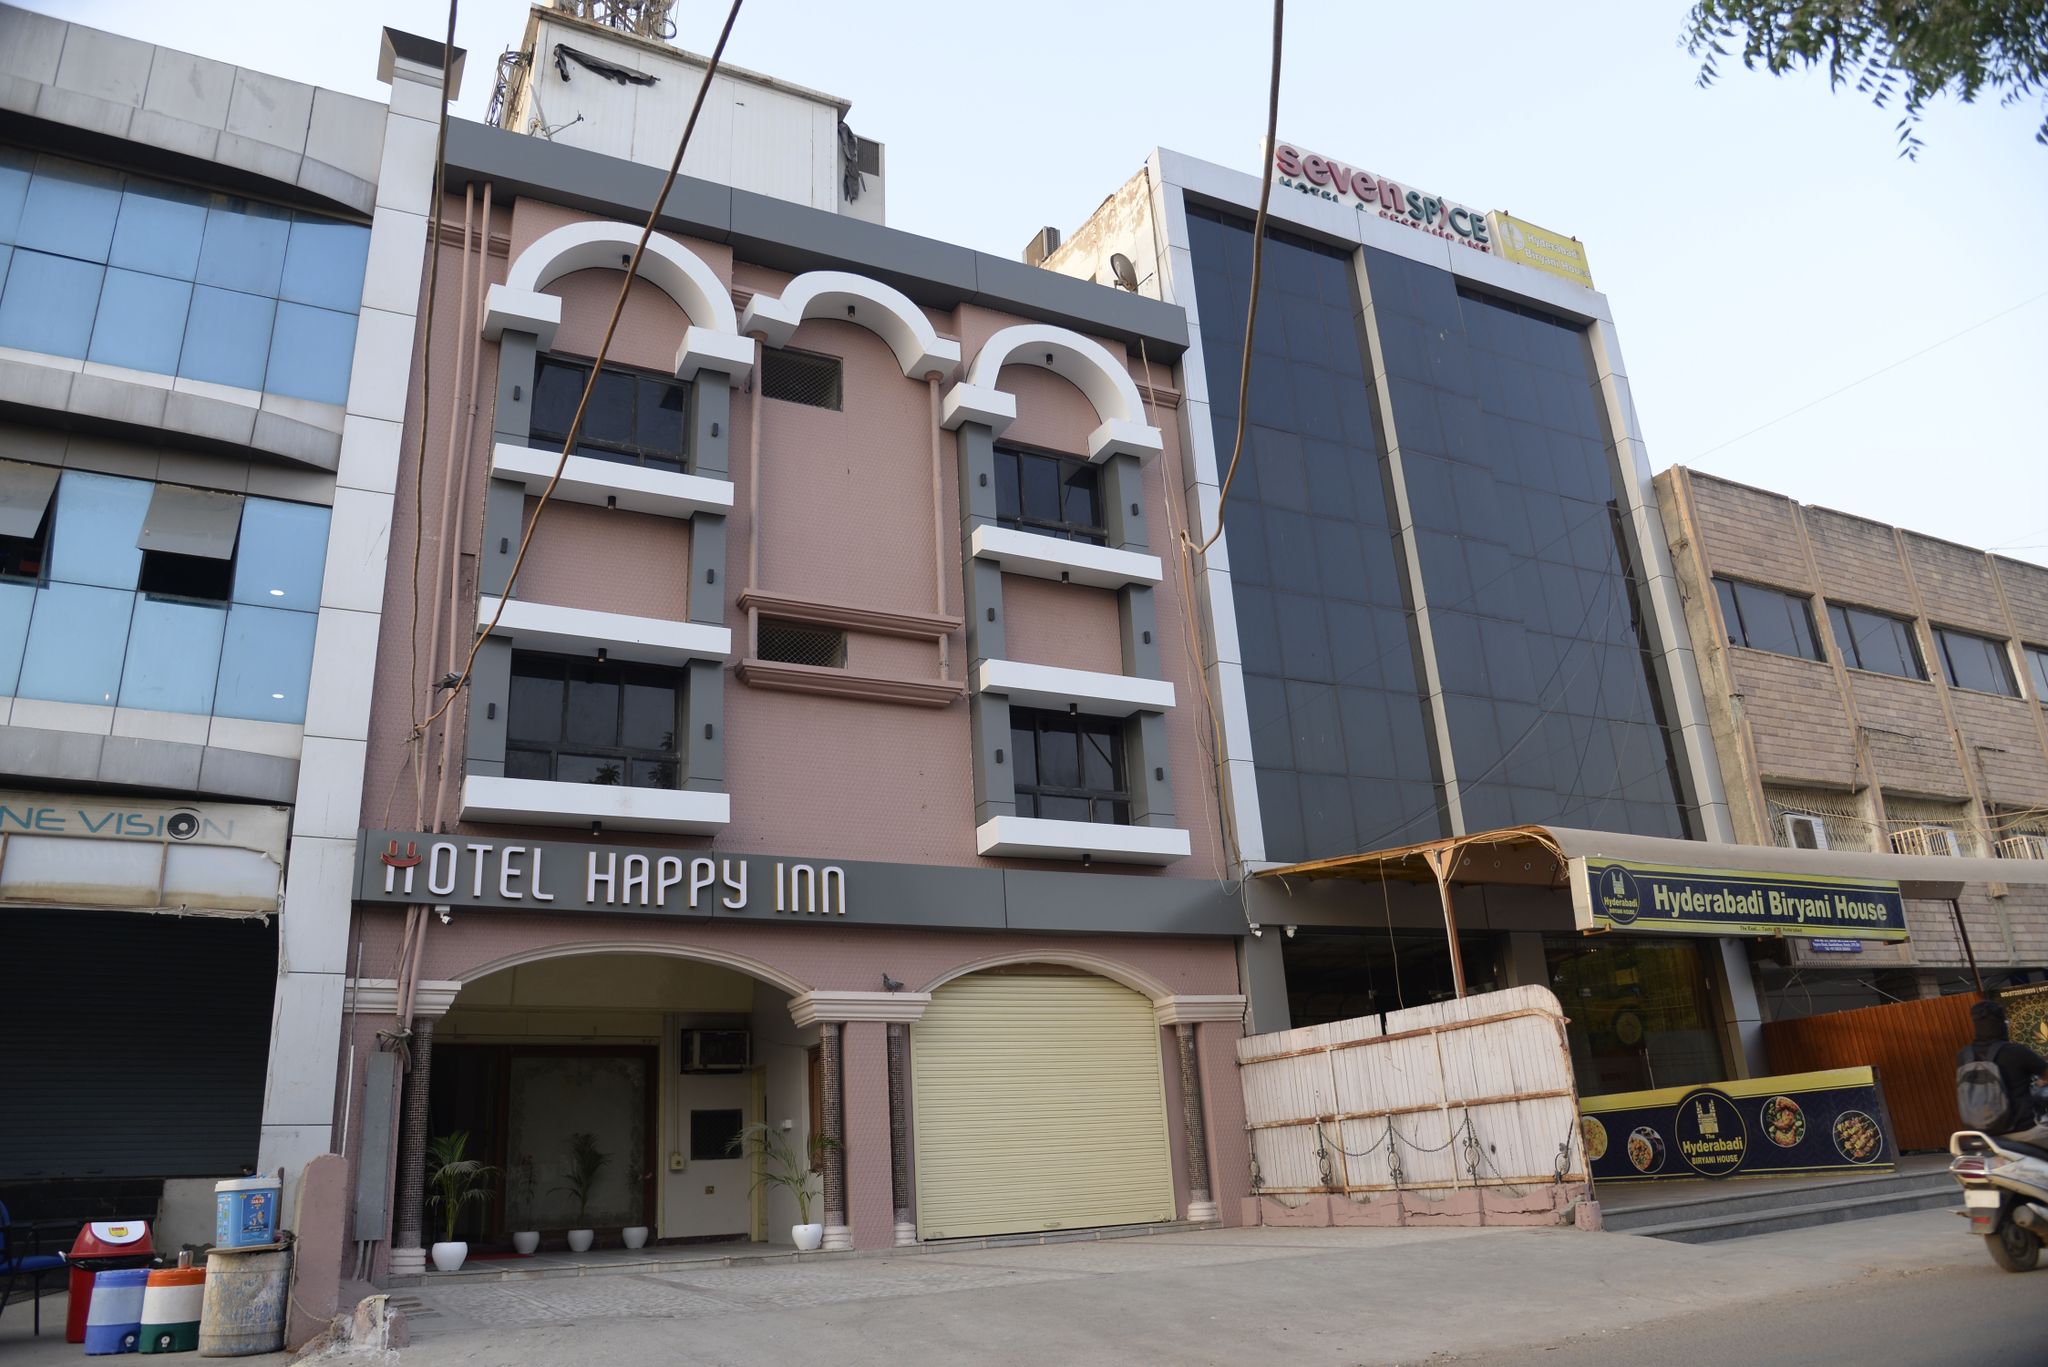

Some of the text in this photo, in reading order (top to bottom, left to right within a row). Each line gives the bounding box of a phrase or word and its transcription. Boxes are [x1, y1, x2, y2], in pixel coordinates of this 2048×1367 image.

[380, 839, 554, 900] HOTEL
[1603, 896, 1638, 908] Hyderabadi
[1652, 884, 1888, 923] Hyderabadi Biryani House
[1682, 1136, 1744, 1155] Hyderabadi
[1691, 1154, 1739, 1165] BIRYANI HOUSE
